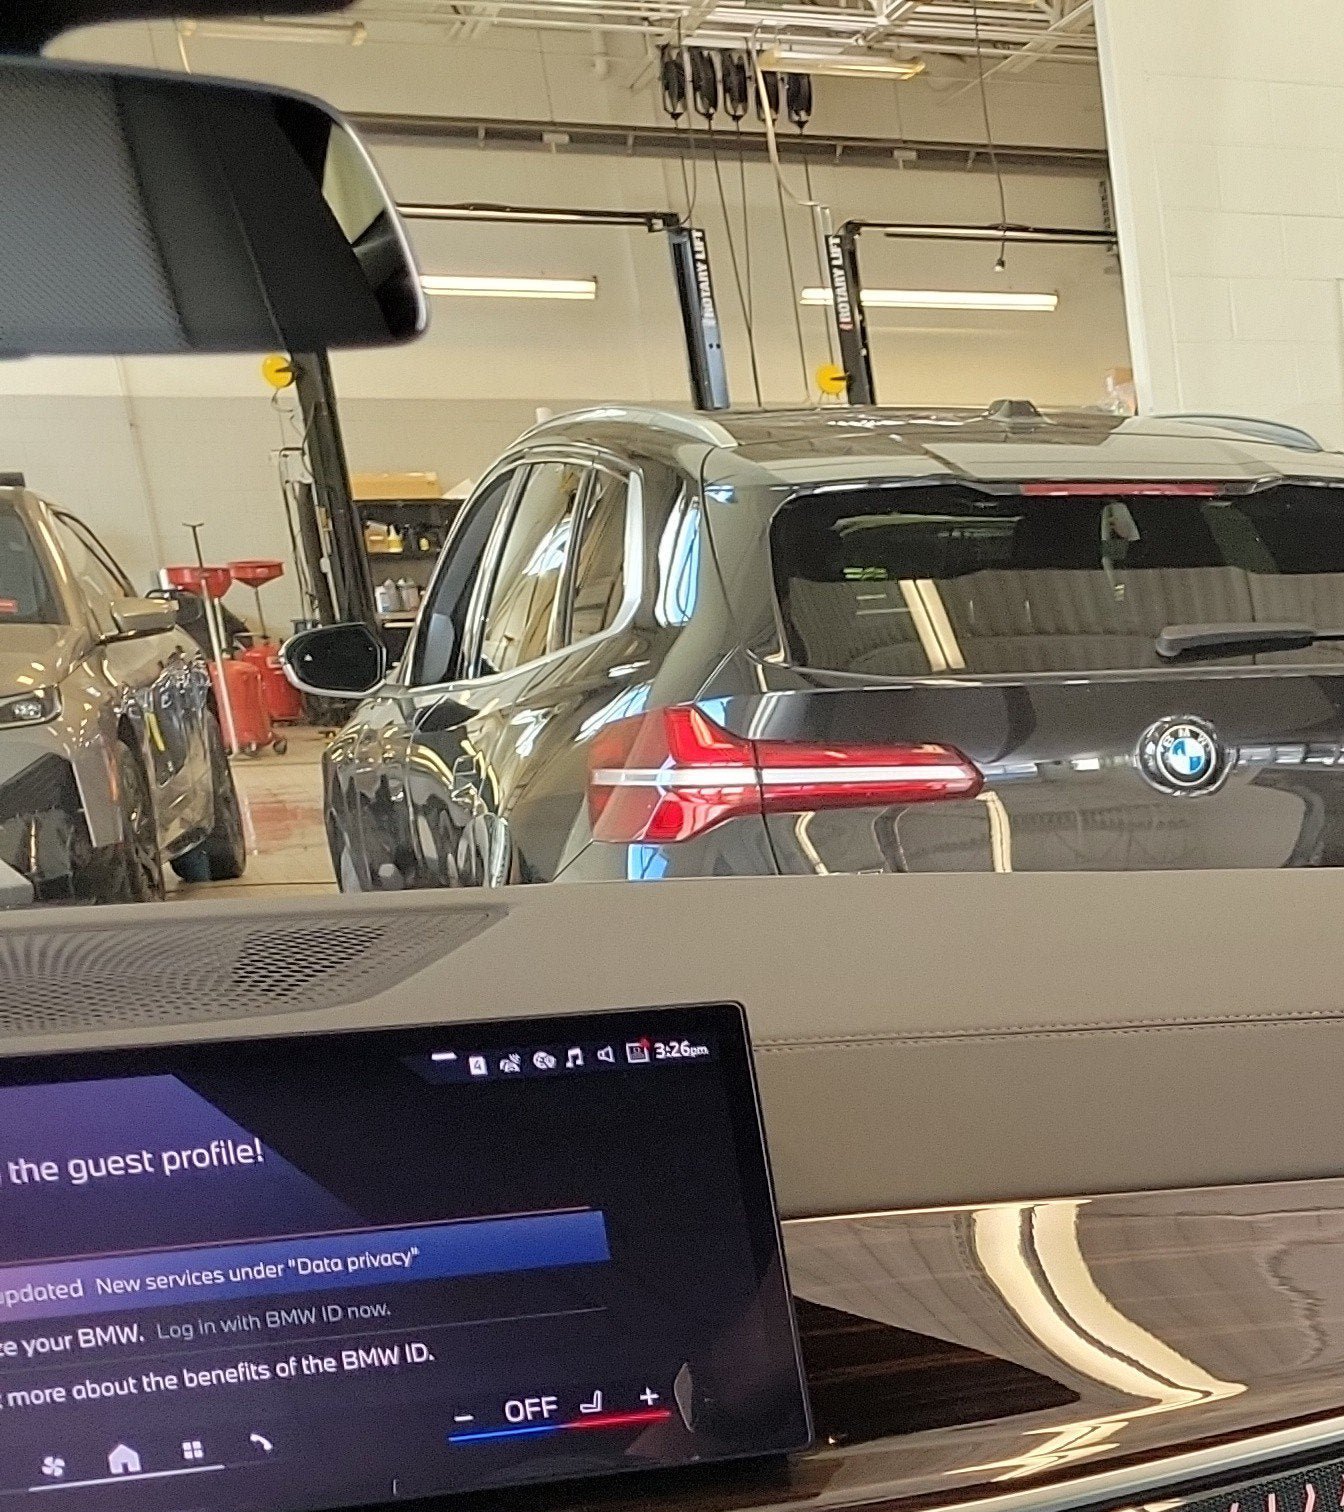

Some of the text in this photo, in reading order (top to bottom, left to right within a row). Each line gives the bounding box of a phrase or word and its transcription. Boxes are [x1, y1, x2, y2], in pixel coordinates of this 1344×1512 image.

[654, 1040, 709, 1060] 3:26pm
[8, 1137, 264, 1185] the guest profile!
[96, 1276, 141, 1296] New
[145, 1267, 224, 1291] services
[229, 1262, 285, 1283] under
[288, 1256, 343, 1277] "Data
[347, 1245, 420, 1274] privacy"
[22, 1333, 73, 1358] your
[77, 1323, 145, 1350] BMW.
[156, 1323, 194, 1343] Log
[198, 1317, 217, 1336] in
[219, 1313, 261, 1333] with
[265, 1307, 317, 1330] BMW
[321, 1304, 342, 1324] ID
[346, 1301, 392, 1321] now.
[7, 1340, 436, 1409] more about the benefits of the BMW ID.
[504, 1396, 558, 1423] OFF
